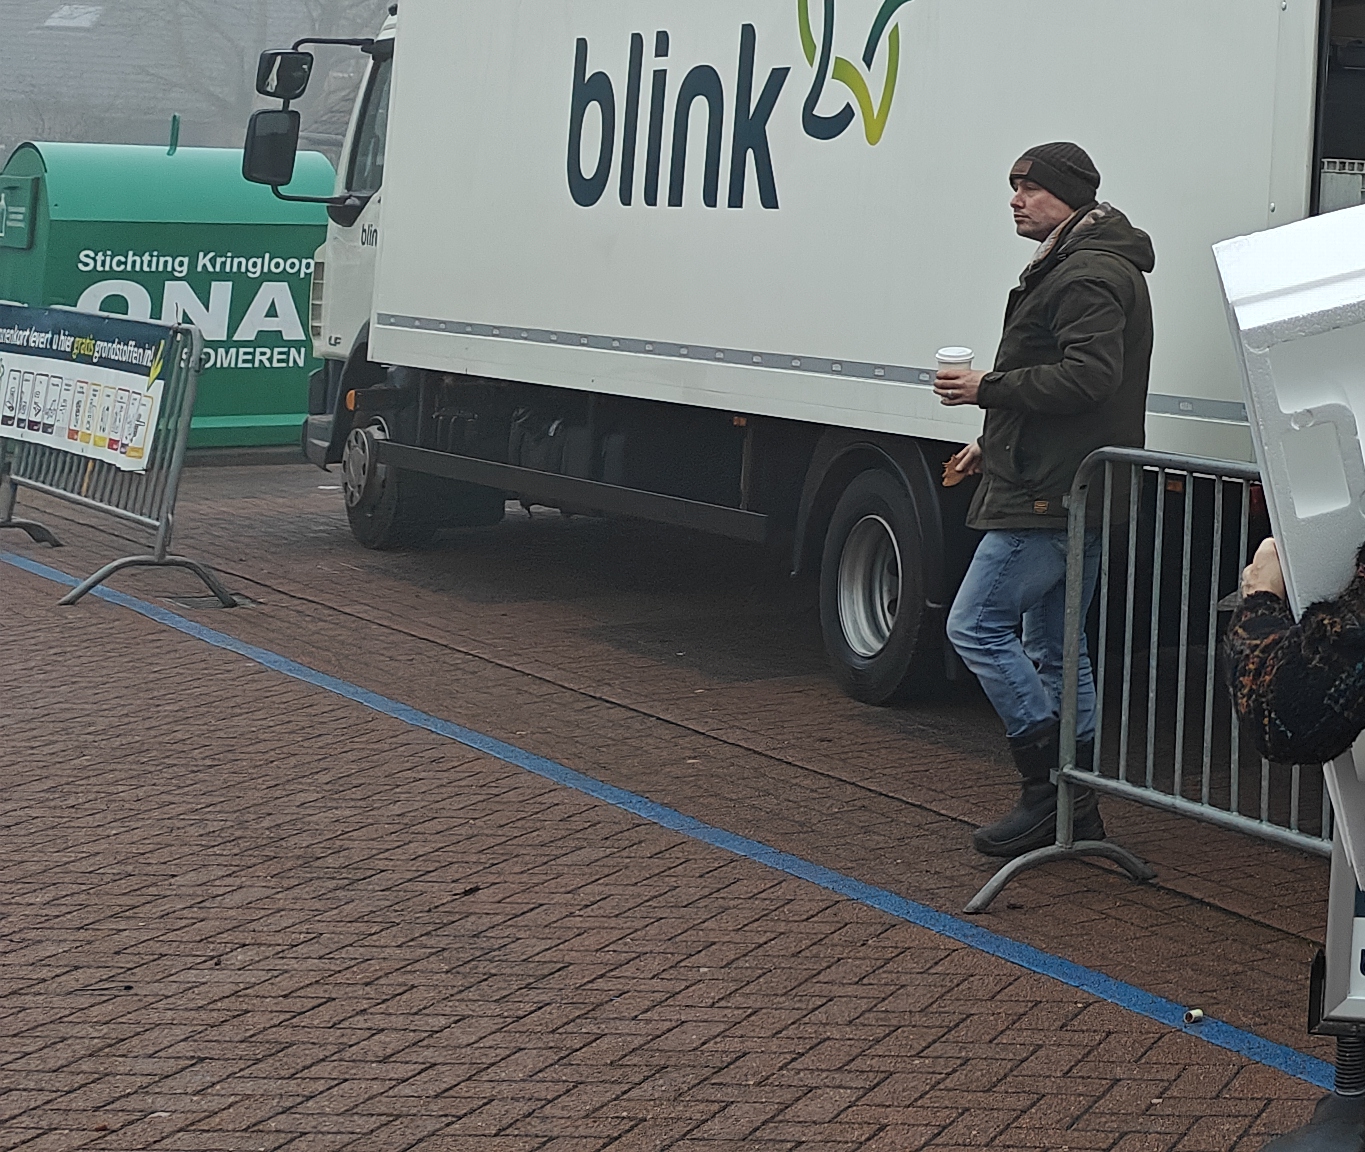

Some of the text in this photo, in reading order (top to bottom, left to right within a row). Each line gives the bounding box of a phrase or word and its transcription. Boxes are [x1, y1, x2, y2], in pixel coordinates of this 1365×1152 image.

[566, 23, 791, 209] blink
[361, 223, 378, 247] blin
[77, 249, 315, 277] Stichting Kringloop
[58, 329, 74, 352] hier
[72, 334, 95, 359] gratis
[92, 338, 143, 365] grondstoffen
